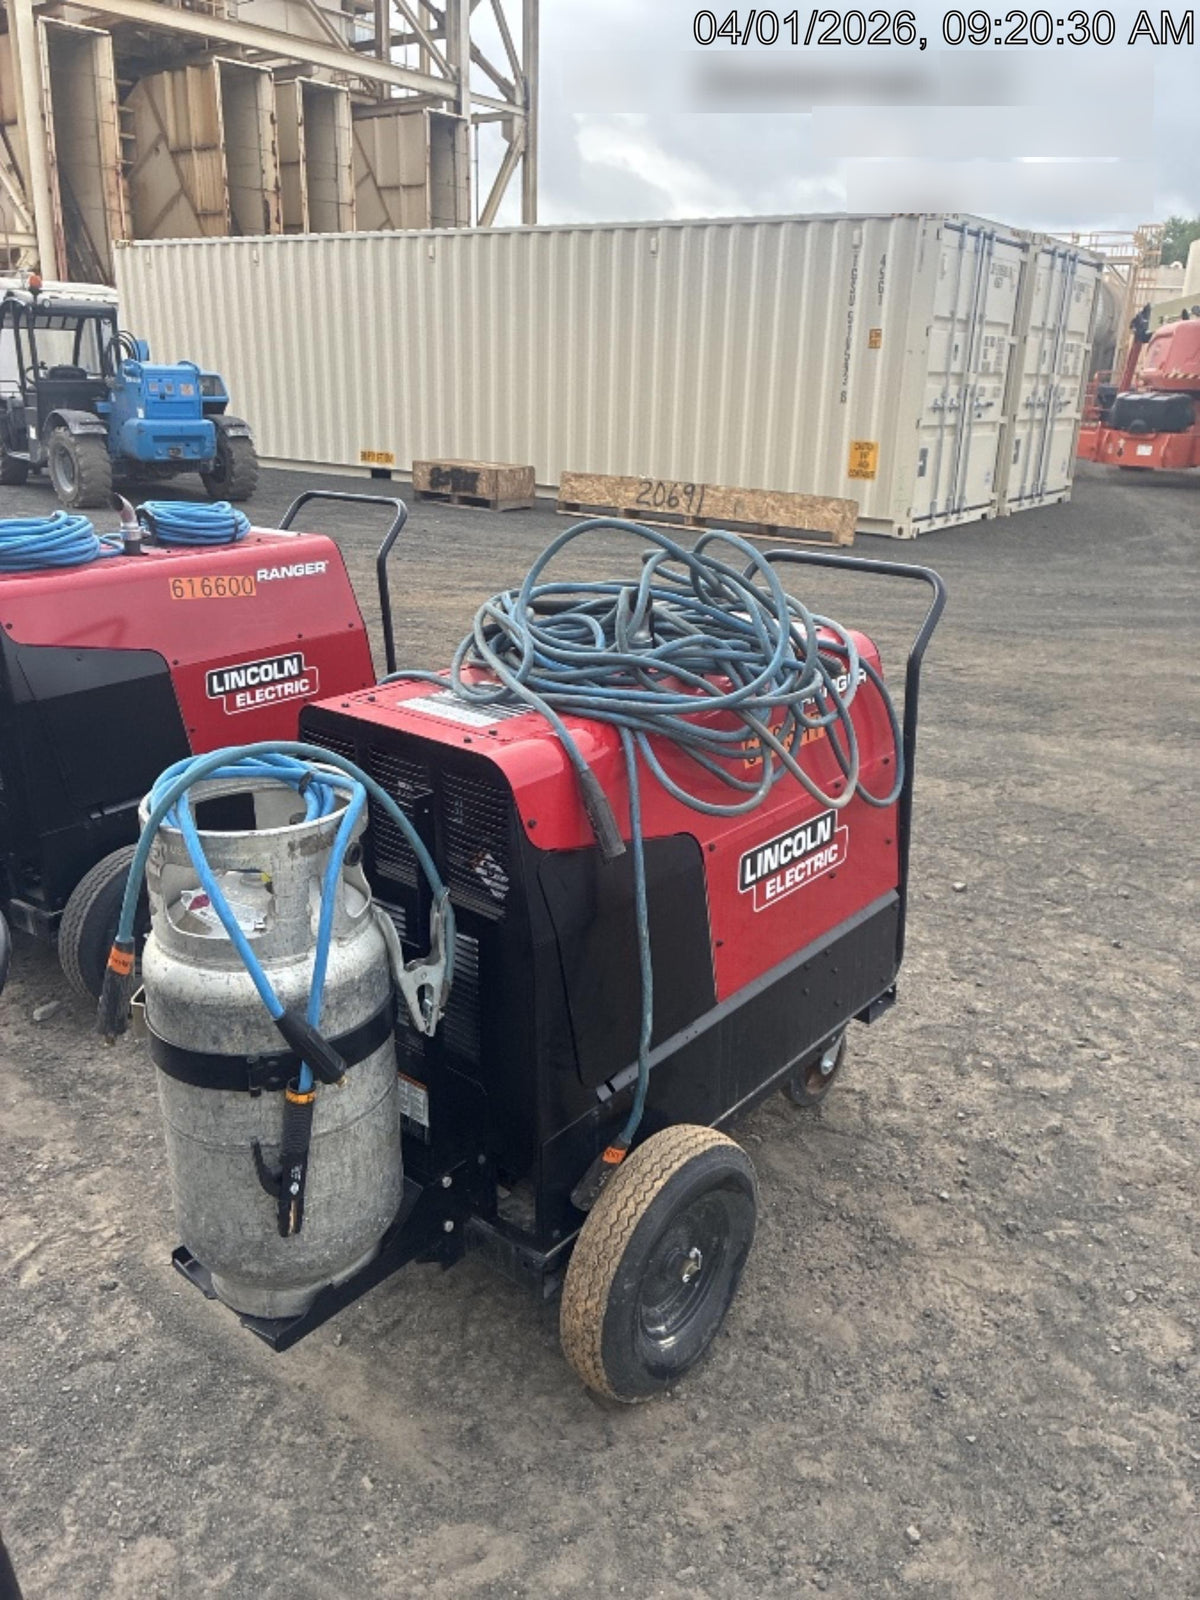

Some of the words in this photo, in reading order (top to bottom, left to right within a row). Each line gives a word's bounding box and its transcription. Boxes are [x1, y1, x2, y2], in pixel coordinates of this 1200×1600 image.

[636, 481, 705, 515] 20691
[171, 576, 254, 598] 616600
[256, 562, 325, 582] RANGER
[212, 657, 299, 694] LINCOLN
[235, 678, 310, 708] ELECTRIC
[744, 816, 832, 885] LINCOLN
[765, 843, 839, 900] ELECTRIC
